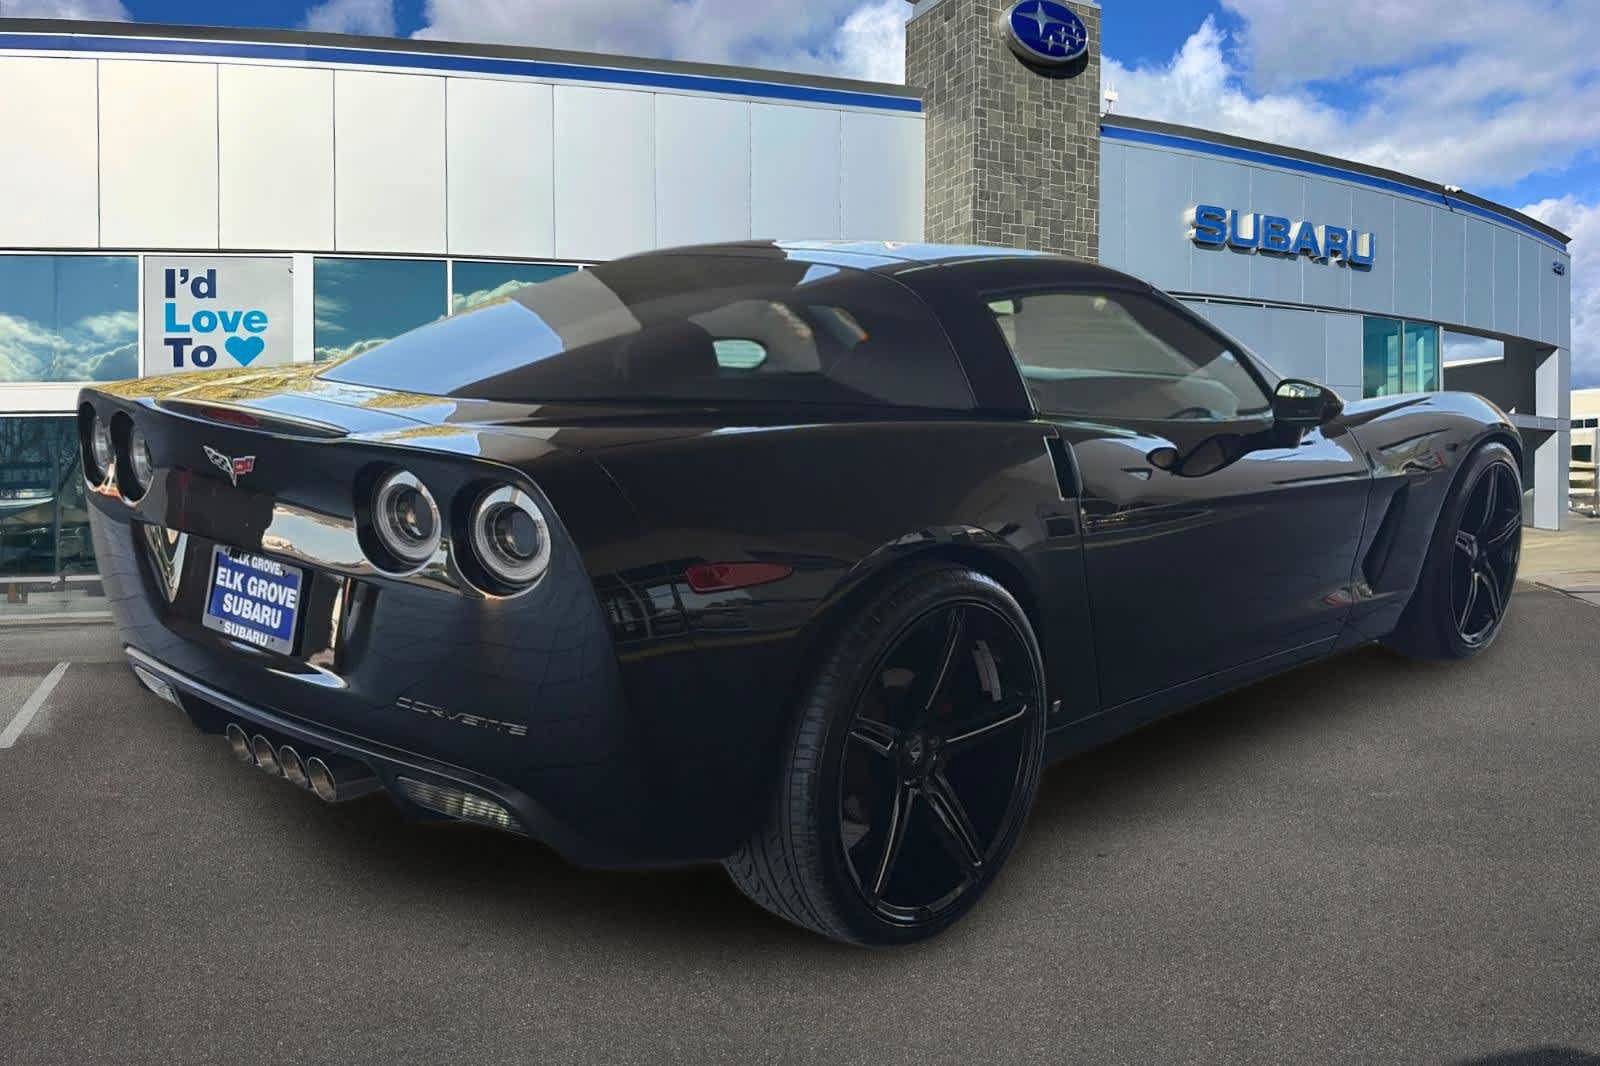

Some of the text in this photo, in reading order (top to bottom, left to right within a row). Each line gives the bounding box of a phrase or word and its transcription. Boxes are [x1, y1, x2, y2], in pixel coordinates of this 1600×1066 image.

[1192, 204, 1376, 267] SUBARU
[165, 303, 268, 333] Love
[164, 338, 217, 368] To
[216, 566, 297, 608] ELK GROVE
[222, 593, 282, 629] SUBARU
[223, 622, 269, 647] SUBARU
